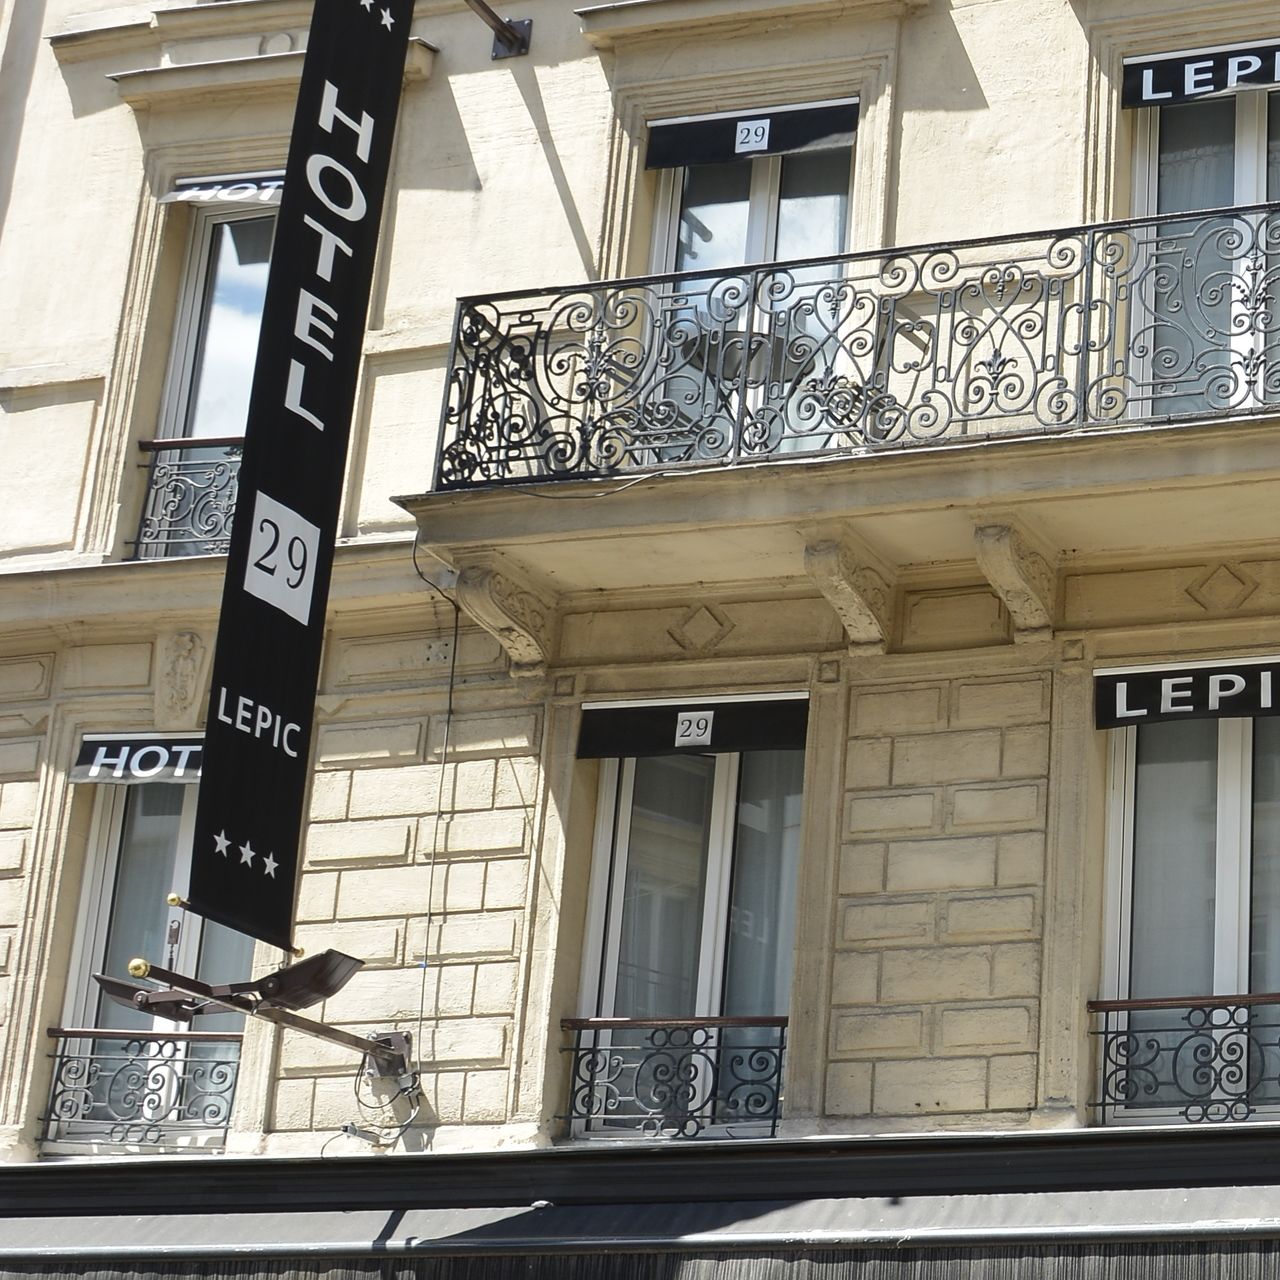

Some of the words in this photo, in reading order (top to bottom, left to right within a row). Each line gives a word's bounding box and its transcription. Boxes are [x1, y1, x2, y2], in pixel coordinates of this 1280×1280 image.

[740, 126, 764, 146] 29
[177, 181, 285, 201] HOT
[284, 79, 375, 432] HOTEL
[253, 518, 308, 590] 29
[217, 686, 301, 759] LEPIC
[680, 716, 708, 739] 29
[88, 745, 203, 777] HOT
